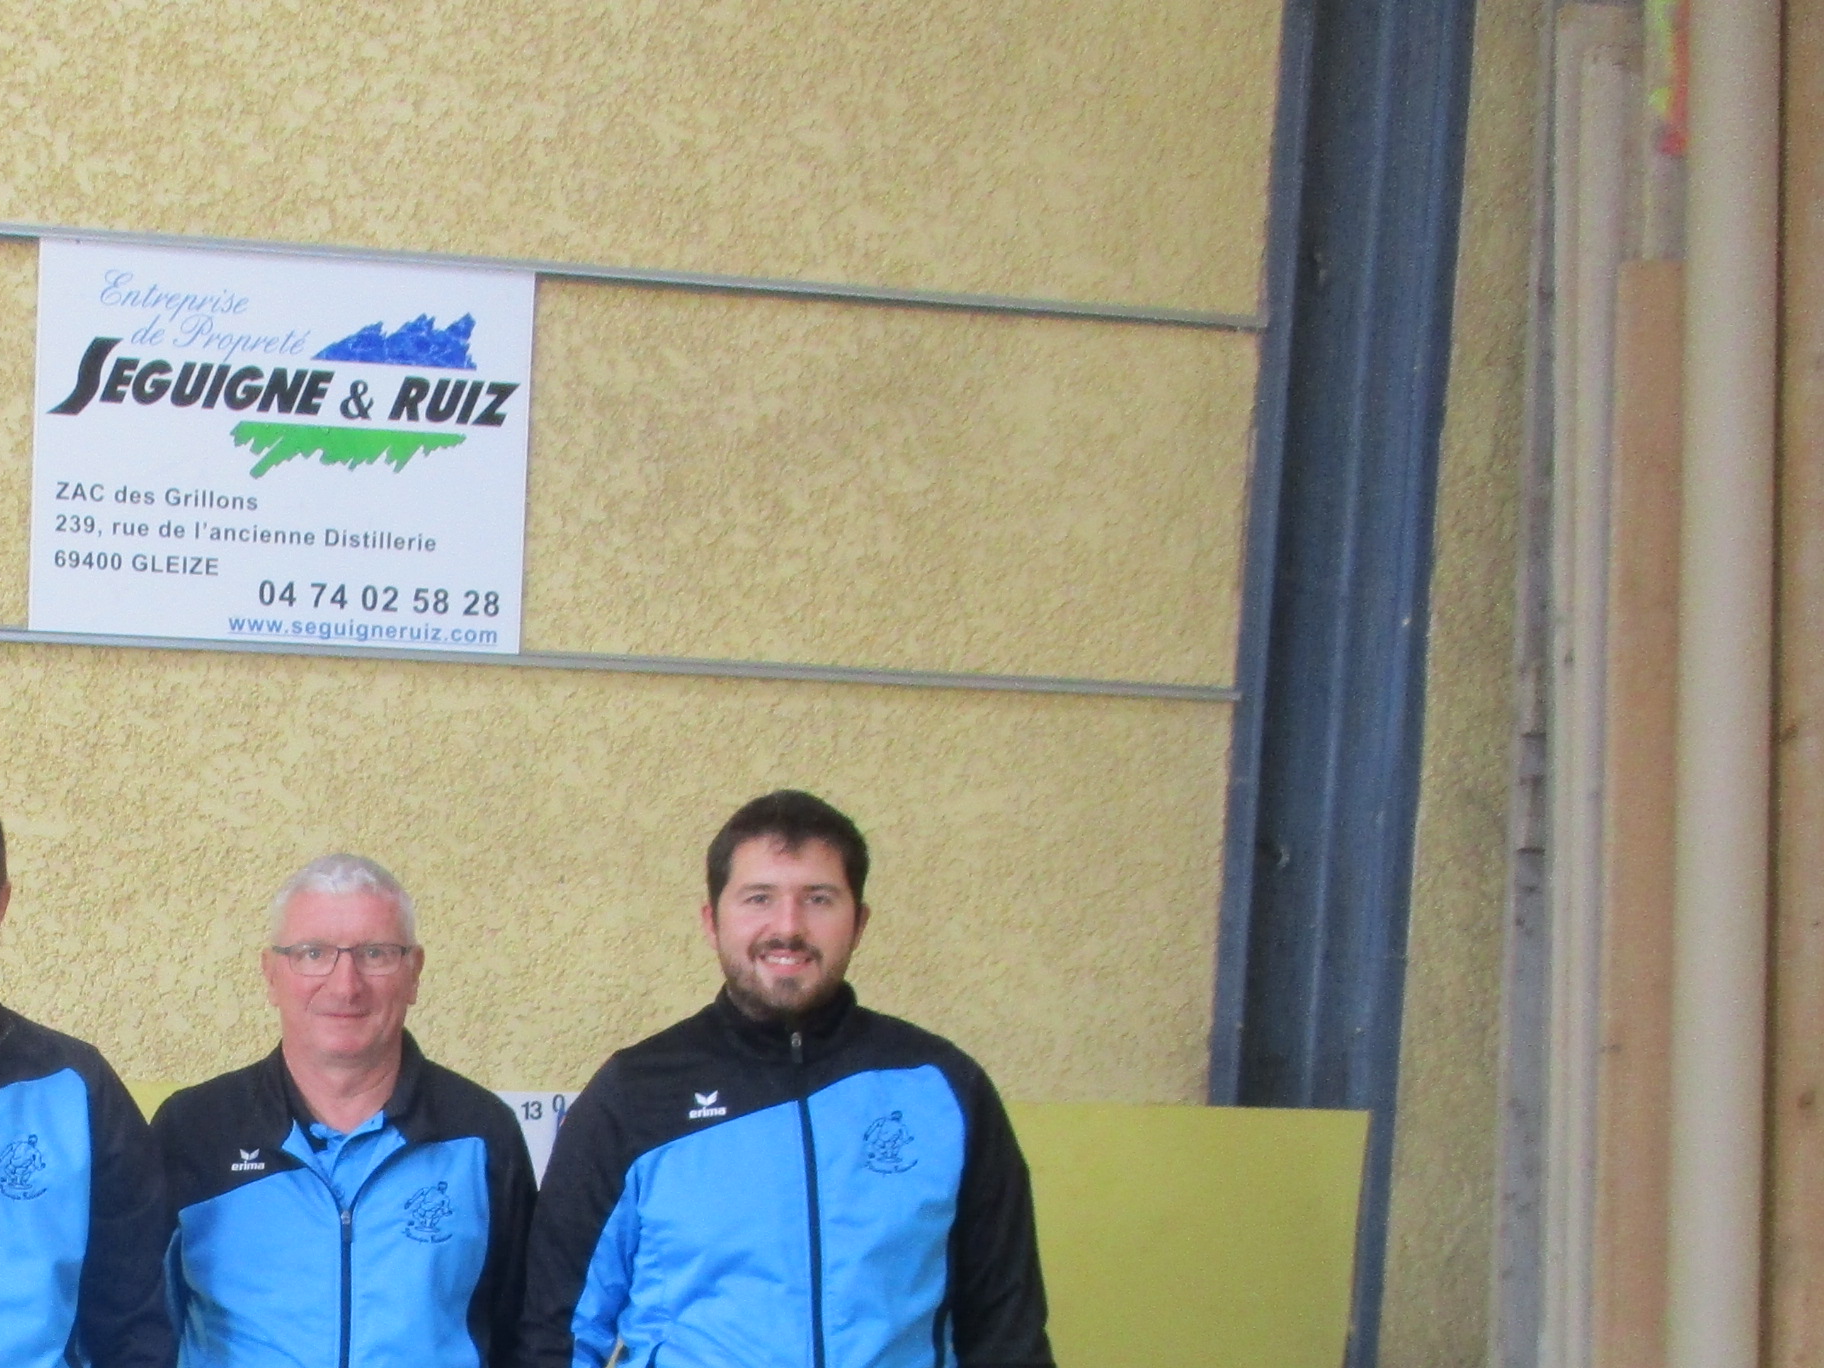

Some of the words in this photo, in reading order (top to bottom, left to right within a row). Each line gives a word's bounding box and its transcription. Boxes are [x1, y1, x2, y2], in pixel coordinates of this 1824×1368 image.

[100, 269, 249, 322] Entreprise
[131, 315, 166, 346] de
[173, 314, 311, 362] Propreté
[47, 337, 335, 416] SEGUIGNE
[340, 379, 375, 420] &
[389, 376, 521, 427] RUIZ
[55, 481, 105, 502] ZAC
[114, 486, 155, 505] des
[165, 488, 259, 511] Grillons
[55, 514, 103, 537] 239,
[112, 521, 149, 537] rue
[158, 520, 185, 539] de
[195, 521, 315, 545] l'ancienne
[325, 528, 437, 552] Distillerie
[54, 550, 123, 571] 69400
[132, 554, 219, 576] GLEIZE
[259, 580, 296, 607] 04
[311, 582, 348, 610] 74
[361, 585, 398, 612] 02
[413, 588, 449, 615] 58
[463, 590, 500, 617] 28
[228, 617, 498, 644] www.seguigneruiz.com
[521, 1101, 543, 1120] 13
[689, 1106, 727, 1119] erima
[231, 1159, 265, 1171] erima
